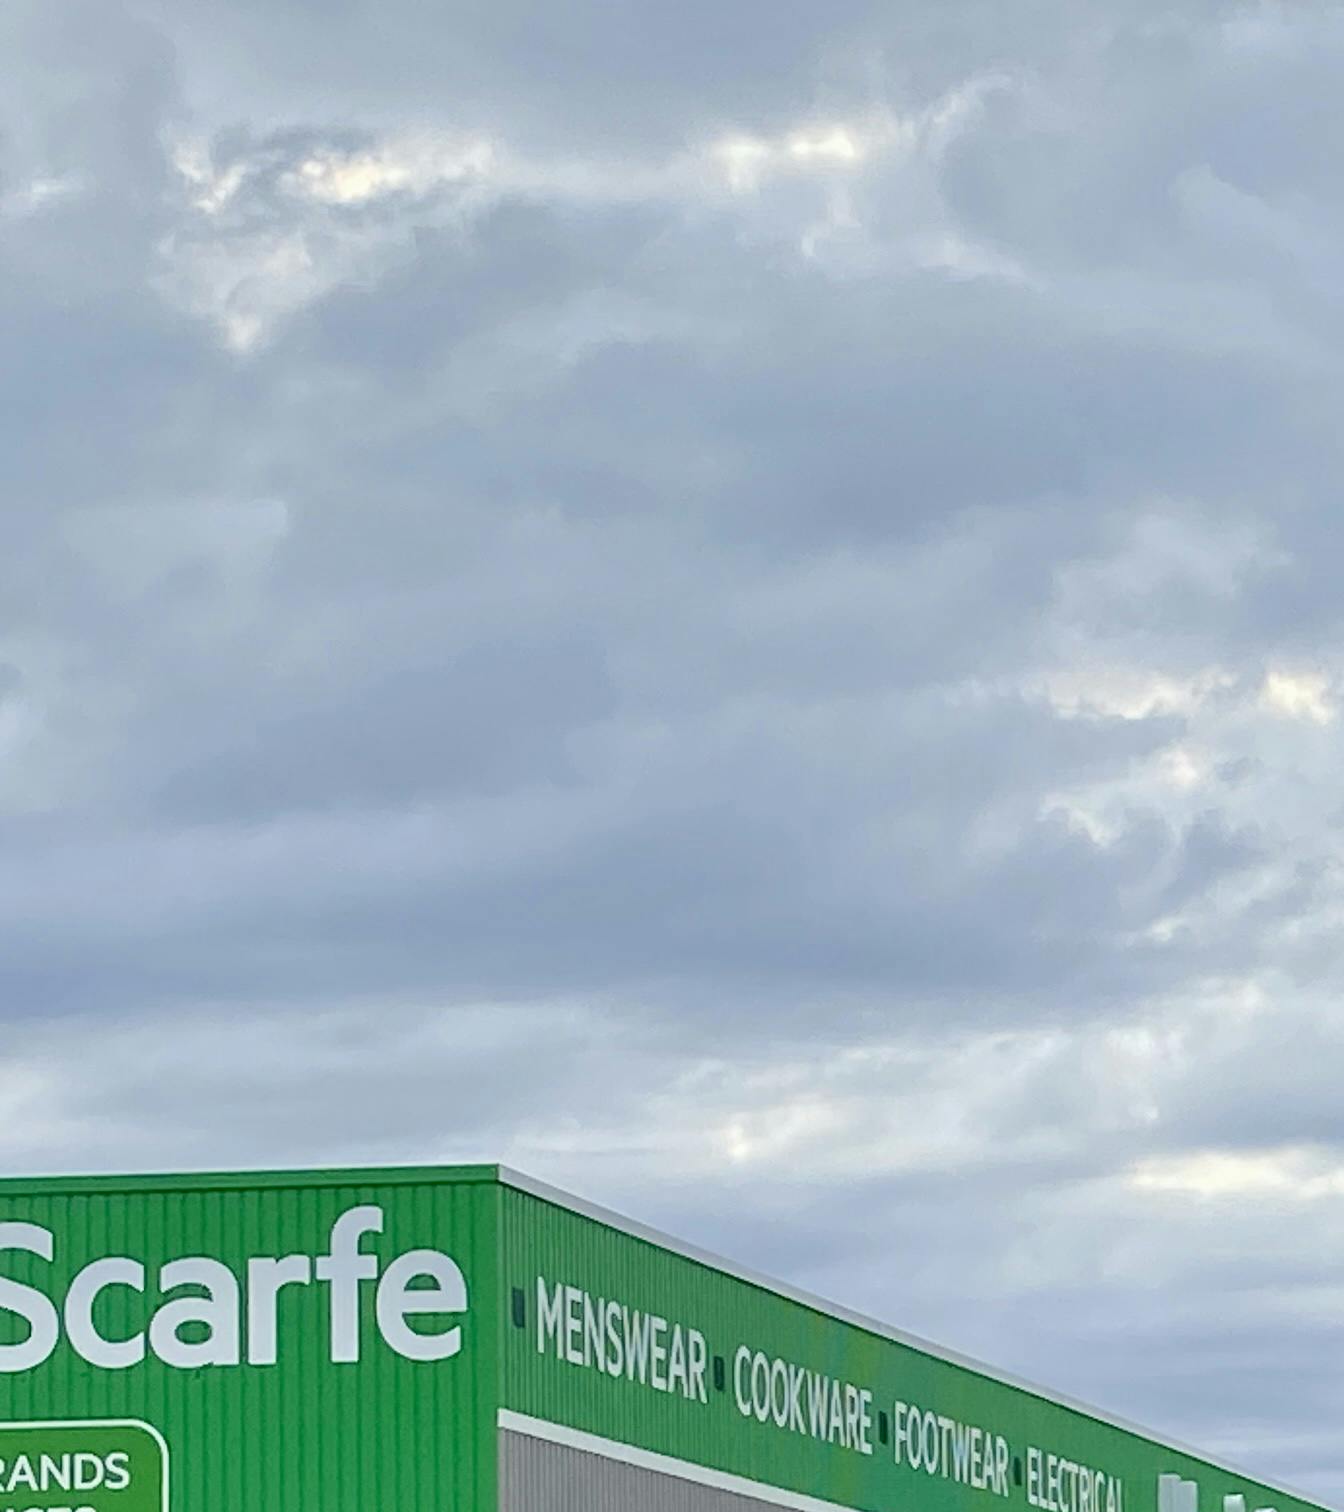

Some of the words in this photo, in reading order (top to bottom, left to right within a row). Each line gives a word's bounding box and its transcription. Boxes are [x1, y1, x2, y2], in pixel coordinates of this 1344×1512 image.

[536, 1275, 708, 1404] MENSWEAR
[733, 1345, 873, 1456] COOKWARE
[894, 1400, 1009, 1498] FOOTWEAR
[0, 1452, 130, 1492] ANDS
